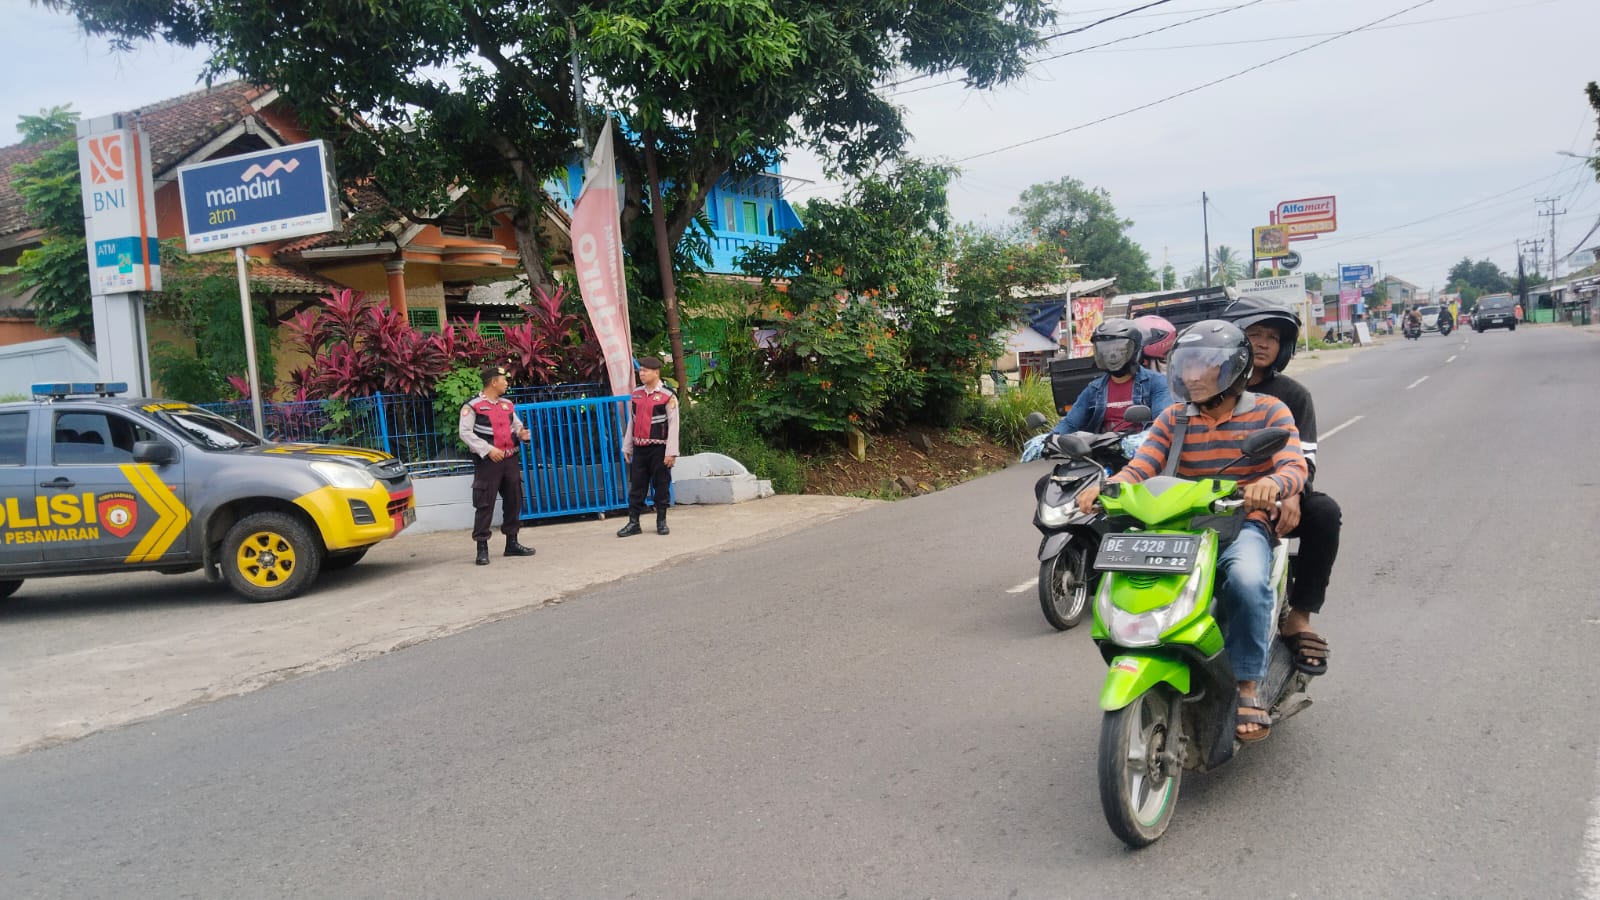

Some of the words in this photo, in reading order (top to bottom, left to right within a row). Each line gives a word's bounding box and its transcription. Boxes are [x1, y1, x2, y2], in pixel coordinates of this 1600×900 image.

[93, 188, 126, 212] BNI
[206, 176, 281, 207] mandiri
[1282, 201, 1330, 213] Alfamart
[208, 207, 237, 225] atm
[98, 244, 116, 255] ATM
[0, 492, 97, 528] LISI
[5, 527, 99, 544] PESAWARAN
[1106, 539, 1124, 552] BE
[1131, 539, 1166, 553] 4328
[1173, 541, 1190, 554] UI
